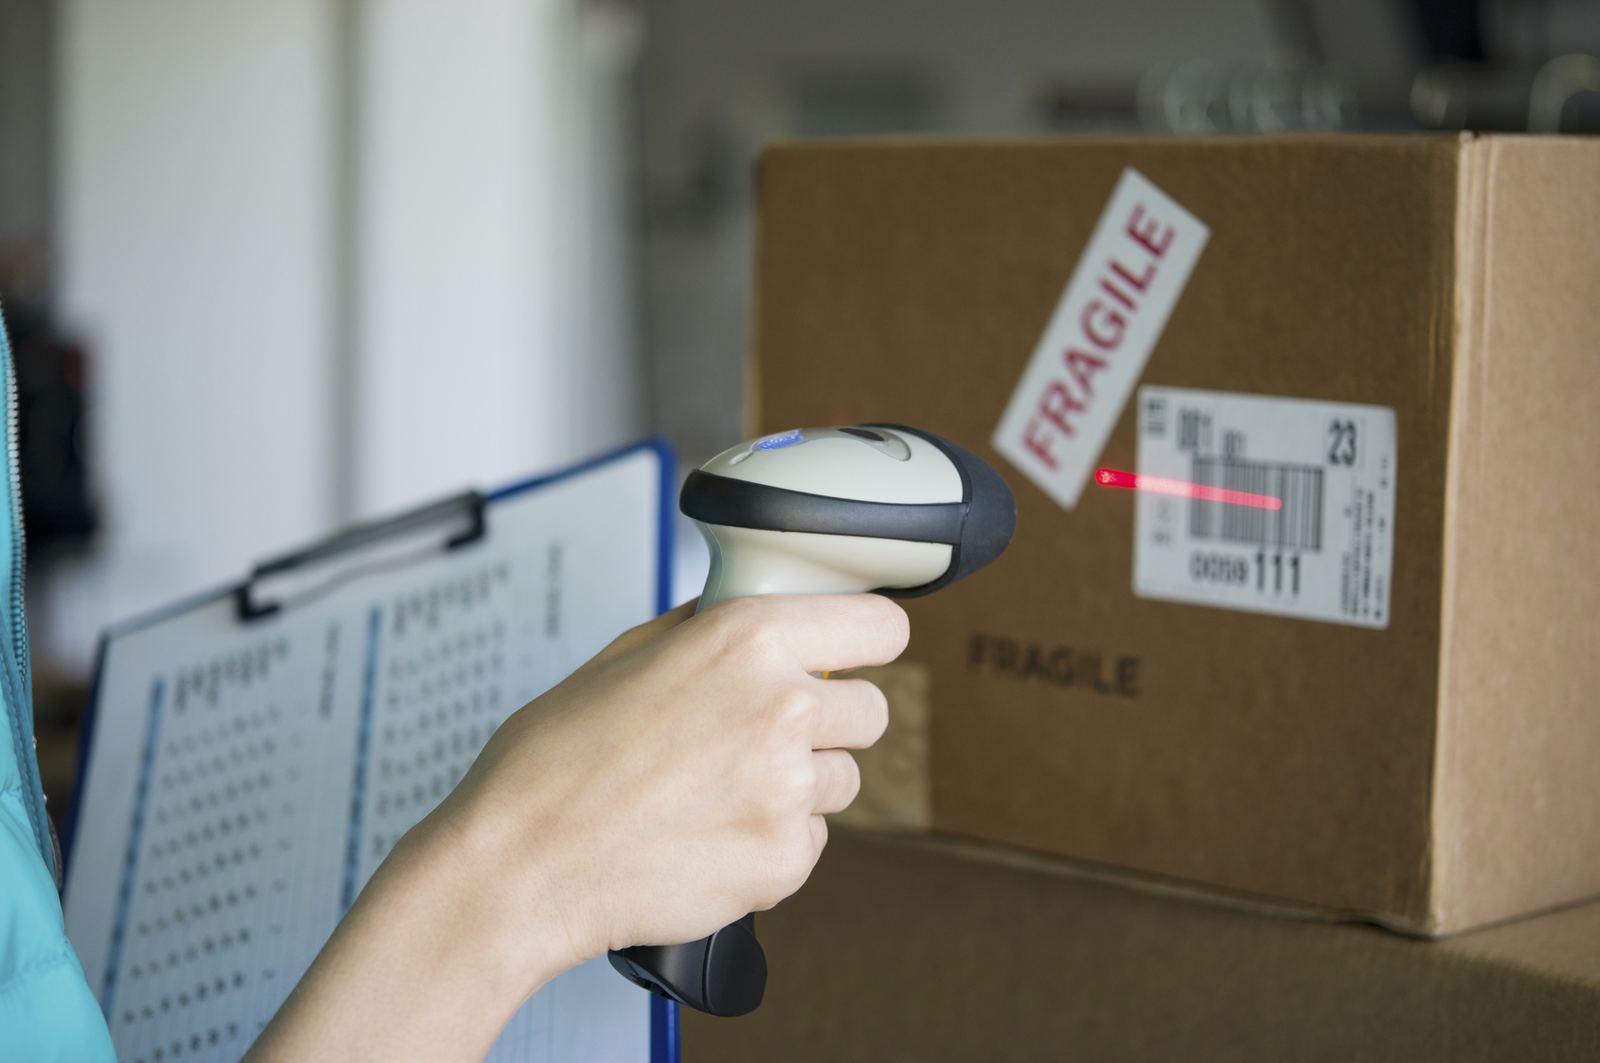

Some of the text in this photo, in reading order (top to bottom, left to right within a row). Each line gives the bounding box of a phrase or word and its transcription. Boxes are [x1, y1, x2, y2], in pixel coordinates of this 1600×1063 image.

[1021, 203, 1176, 472] FRAGILE
[1327, 418, 1357, 467] 23
[967, 631, 1140, 697] FRAGILE
